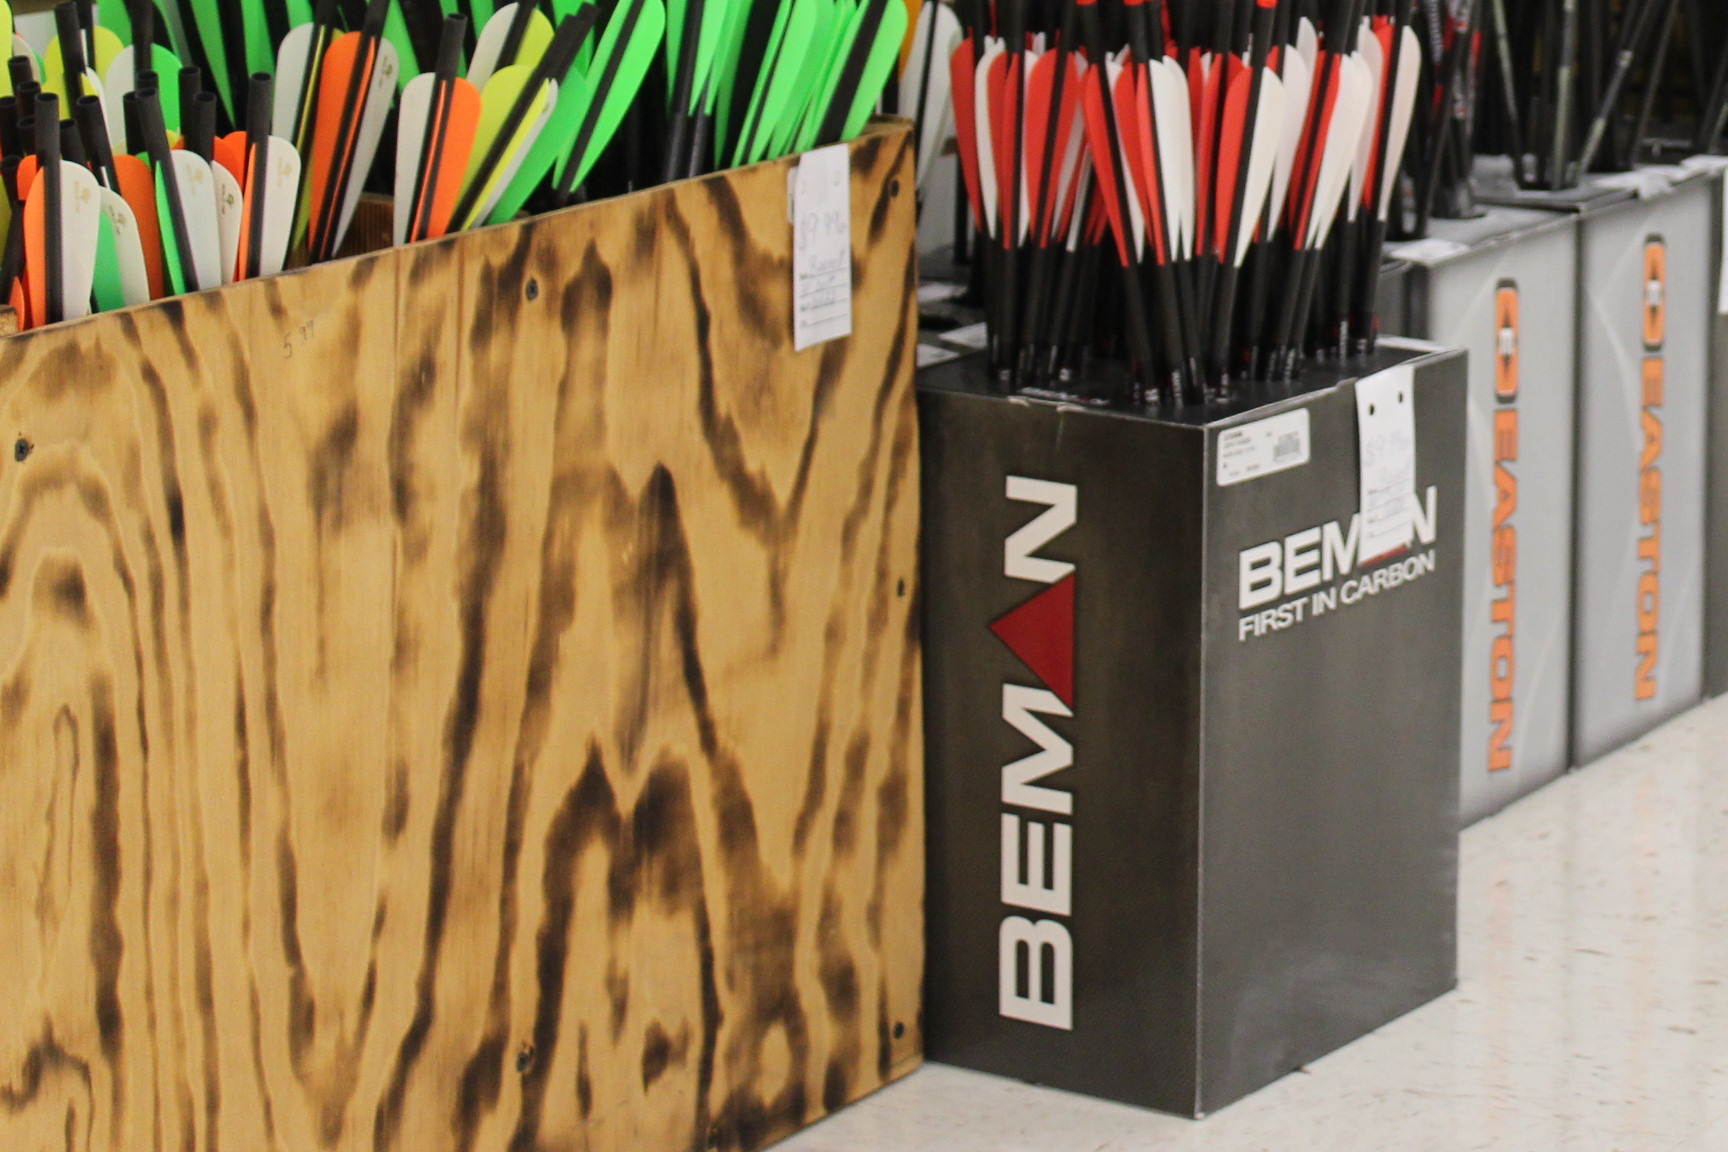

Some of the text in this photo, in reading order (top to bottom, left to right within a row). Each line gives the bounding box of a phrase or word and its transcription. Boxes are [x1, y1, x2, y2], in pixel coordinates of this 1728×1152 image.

[1239, 485, 1437, 610] BEMN
[1239, 550, 1435, 641] FIRST IN CARBON
[1488, 409, 1518, 771] EASTON
[1634, 357, 1664, 701] EASTON
